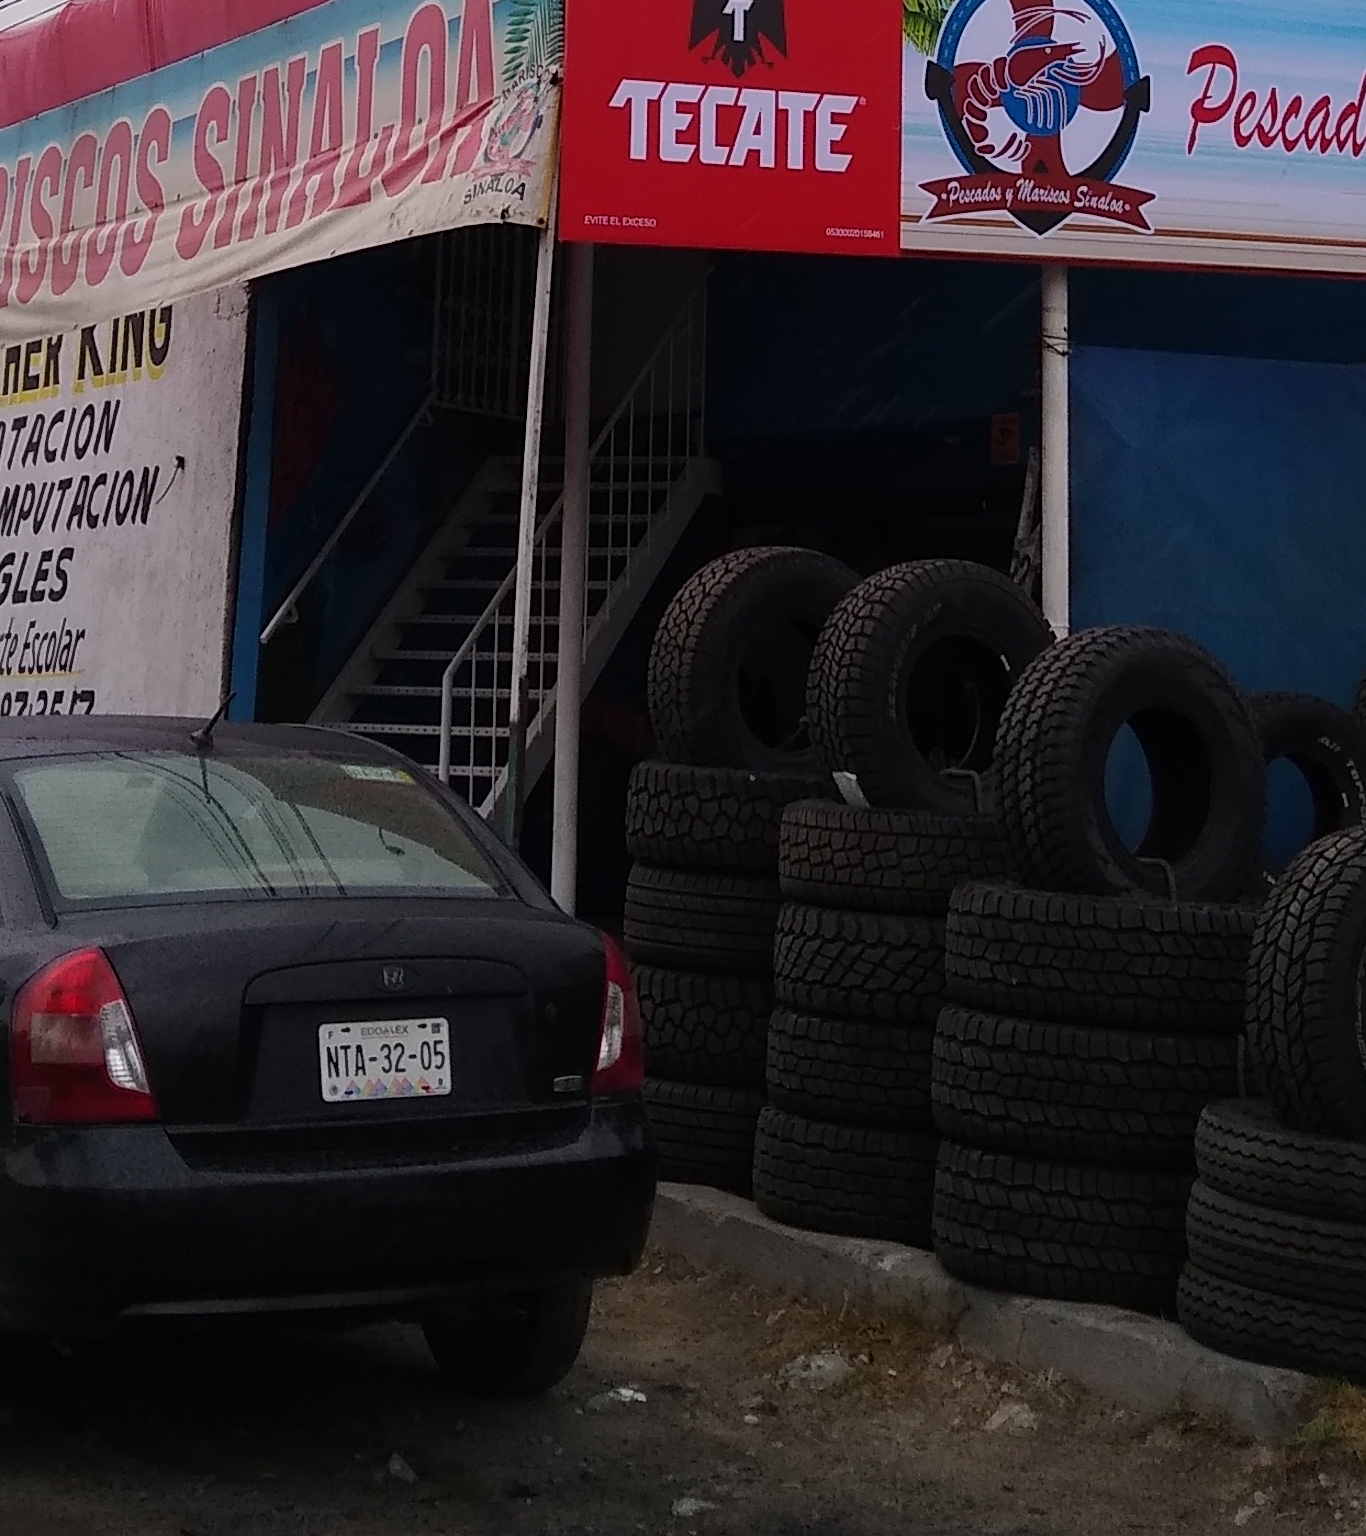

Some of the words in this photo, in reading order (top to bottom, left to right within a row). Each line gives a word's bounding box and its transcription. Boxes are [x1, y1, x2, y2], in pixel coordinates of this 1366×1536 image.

[608, 77, 859, 174] TECATE
[463, 177, 526, 205] SINALOA
[946, 180, 1002, 208] Pescados
[1004, 187, 1014, 208] y
[1016, 177, 1071, 204] Mariscos
[1073, 185, 1124, 214] Sinaloa
[584, 215, 608, 226] EVITE
[609, 216, 621, 227] EL
[622, 217, 657, 228] EXCESO
[77, 305, 173, 381] KING
[19, 617, 86, 675] Escolar
[326, 1039, 446, 1079] NTA-32-05
